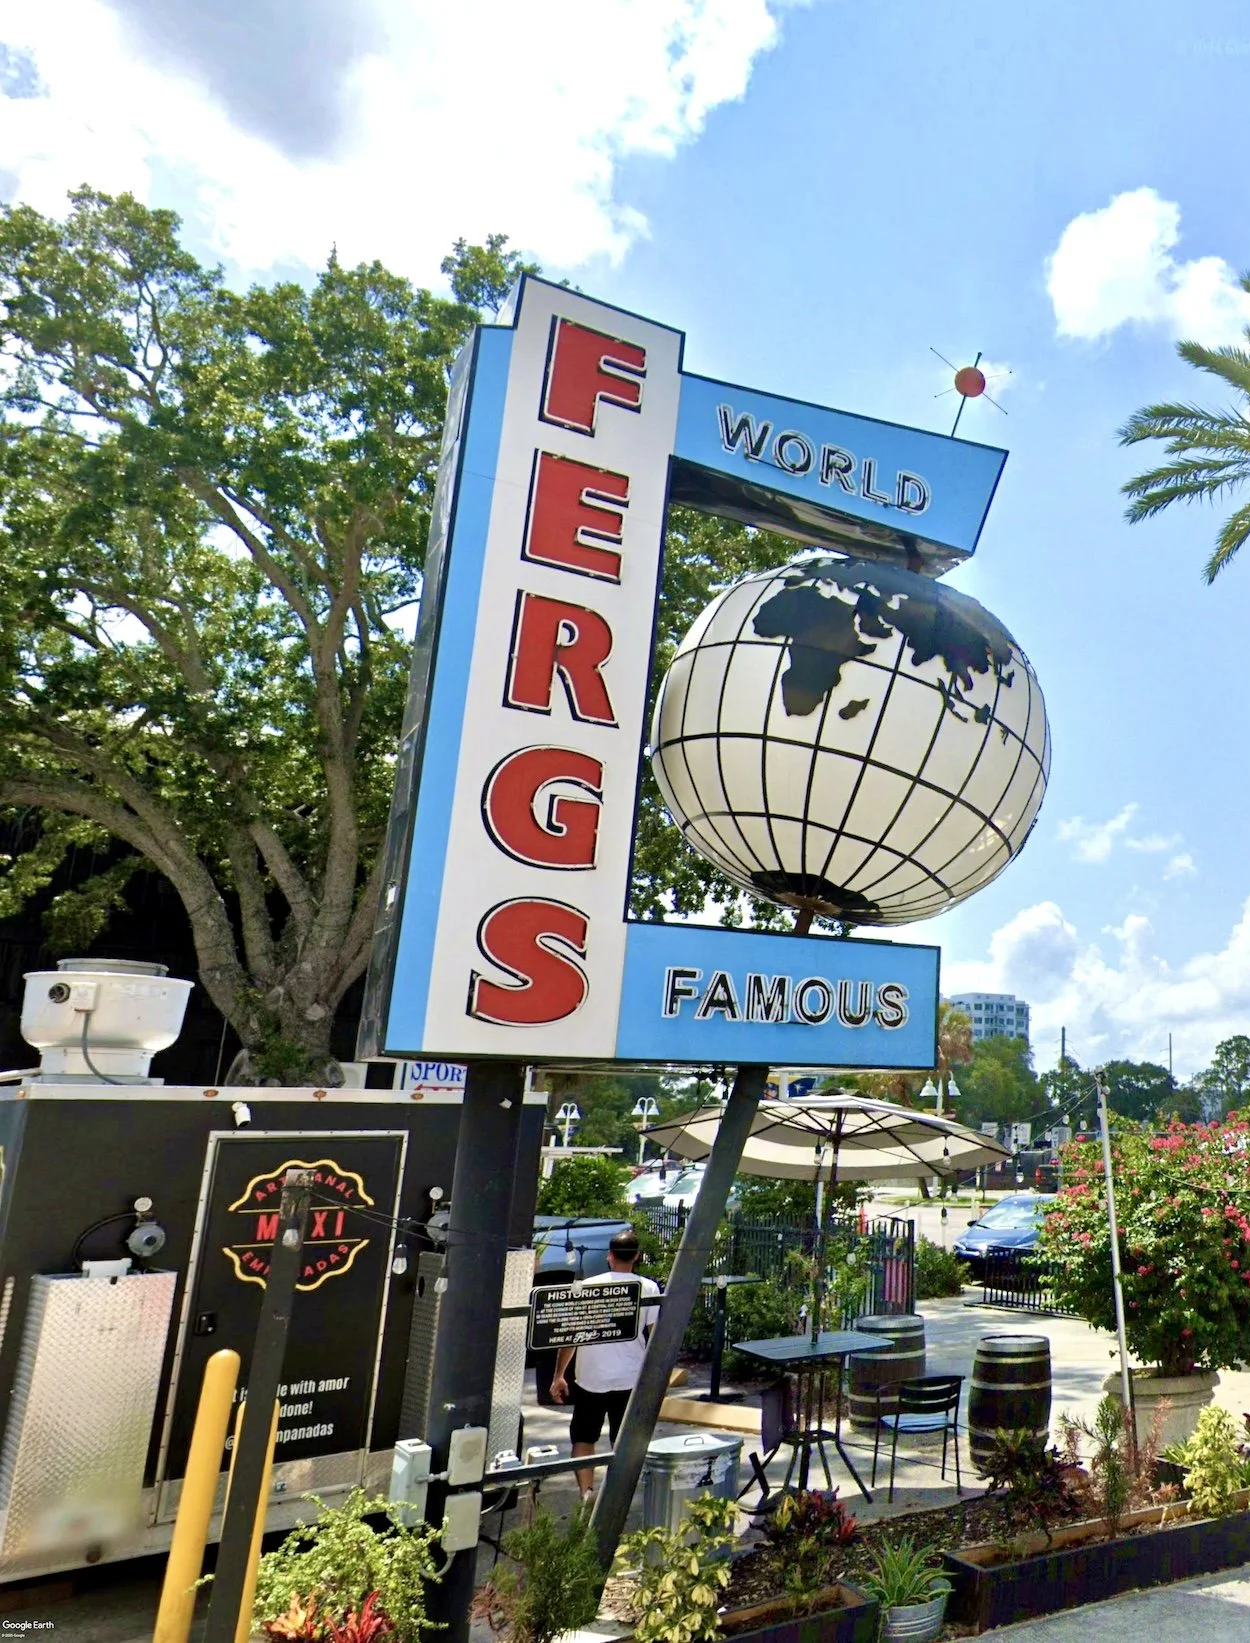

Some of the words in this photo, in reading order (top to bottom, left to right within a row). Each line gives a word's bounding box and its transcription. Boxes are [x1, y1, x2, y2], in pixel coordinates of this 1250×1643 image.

[716, 403, 931, 516] WORLD
[465, 313, 648, 1028] FERGS
[661, 966, 909, 1030] FAMOUS
[255, 1172, 356, 1202] ARTANAL
[256, 1211, 345, 1241] MXI
[241, 1244, 350, 1278] EMADAS
[547, 1287, 600, 1301] HISTORIC
[602, 1286, 629, 1296] SIGN
[602, 1329, 622, 1337] 2019
[290, 1380, 317, 1395] with
[317, 1377, 350, 1392] amor
[279, 1401, 314, 1418] done!
